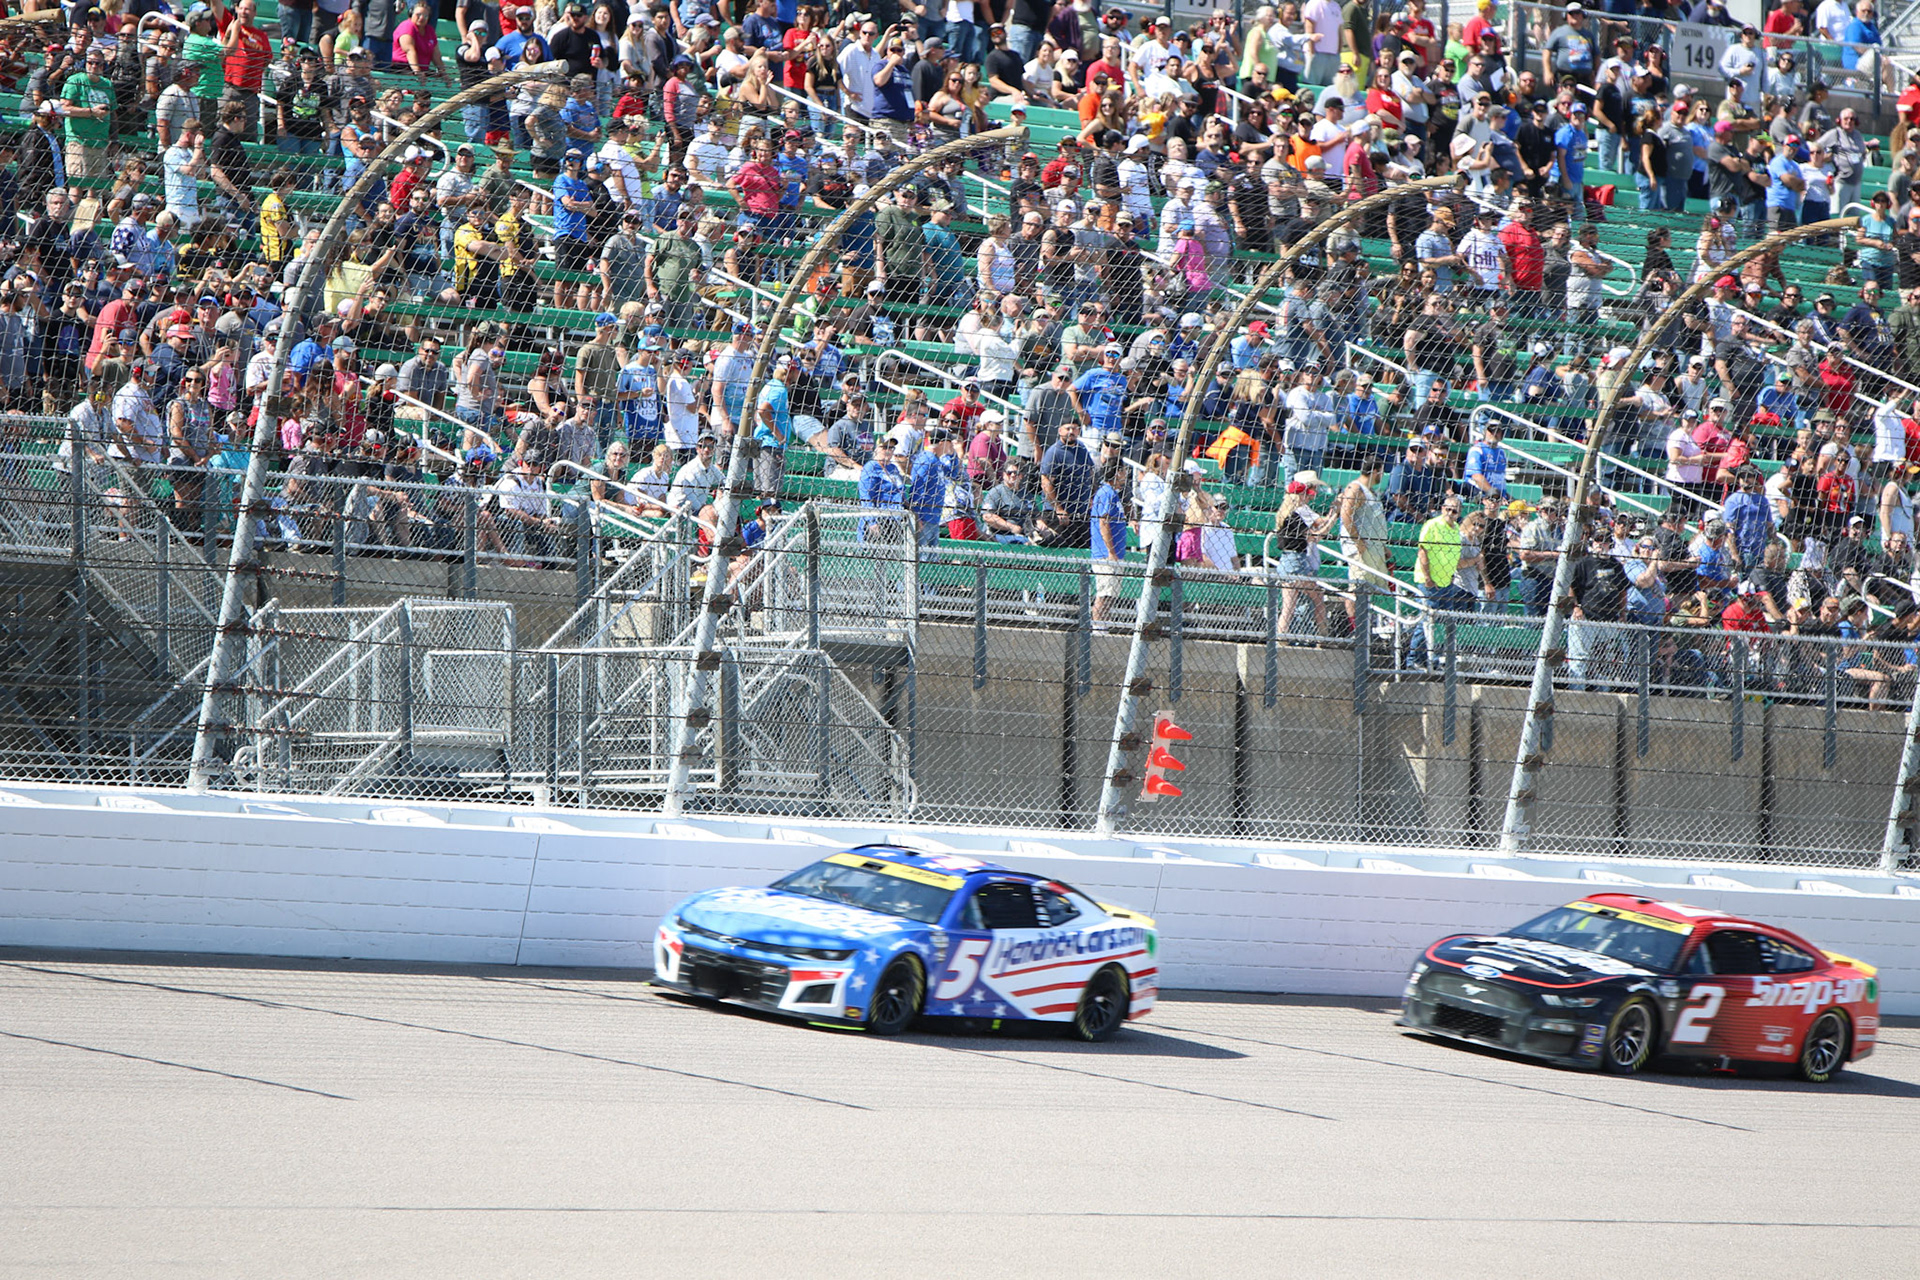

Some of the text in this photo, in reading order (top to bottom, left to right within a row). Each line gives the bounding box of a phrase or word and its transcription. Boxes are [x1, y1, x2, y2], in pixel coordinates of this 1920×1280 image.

[1685, 43, 1715, 69] 149
[934, 938, 991, 1001] 5
[1671, 983, 1726, 1044] 2
[1744, 976, 1866, 1015] Snap-on
